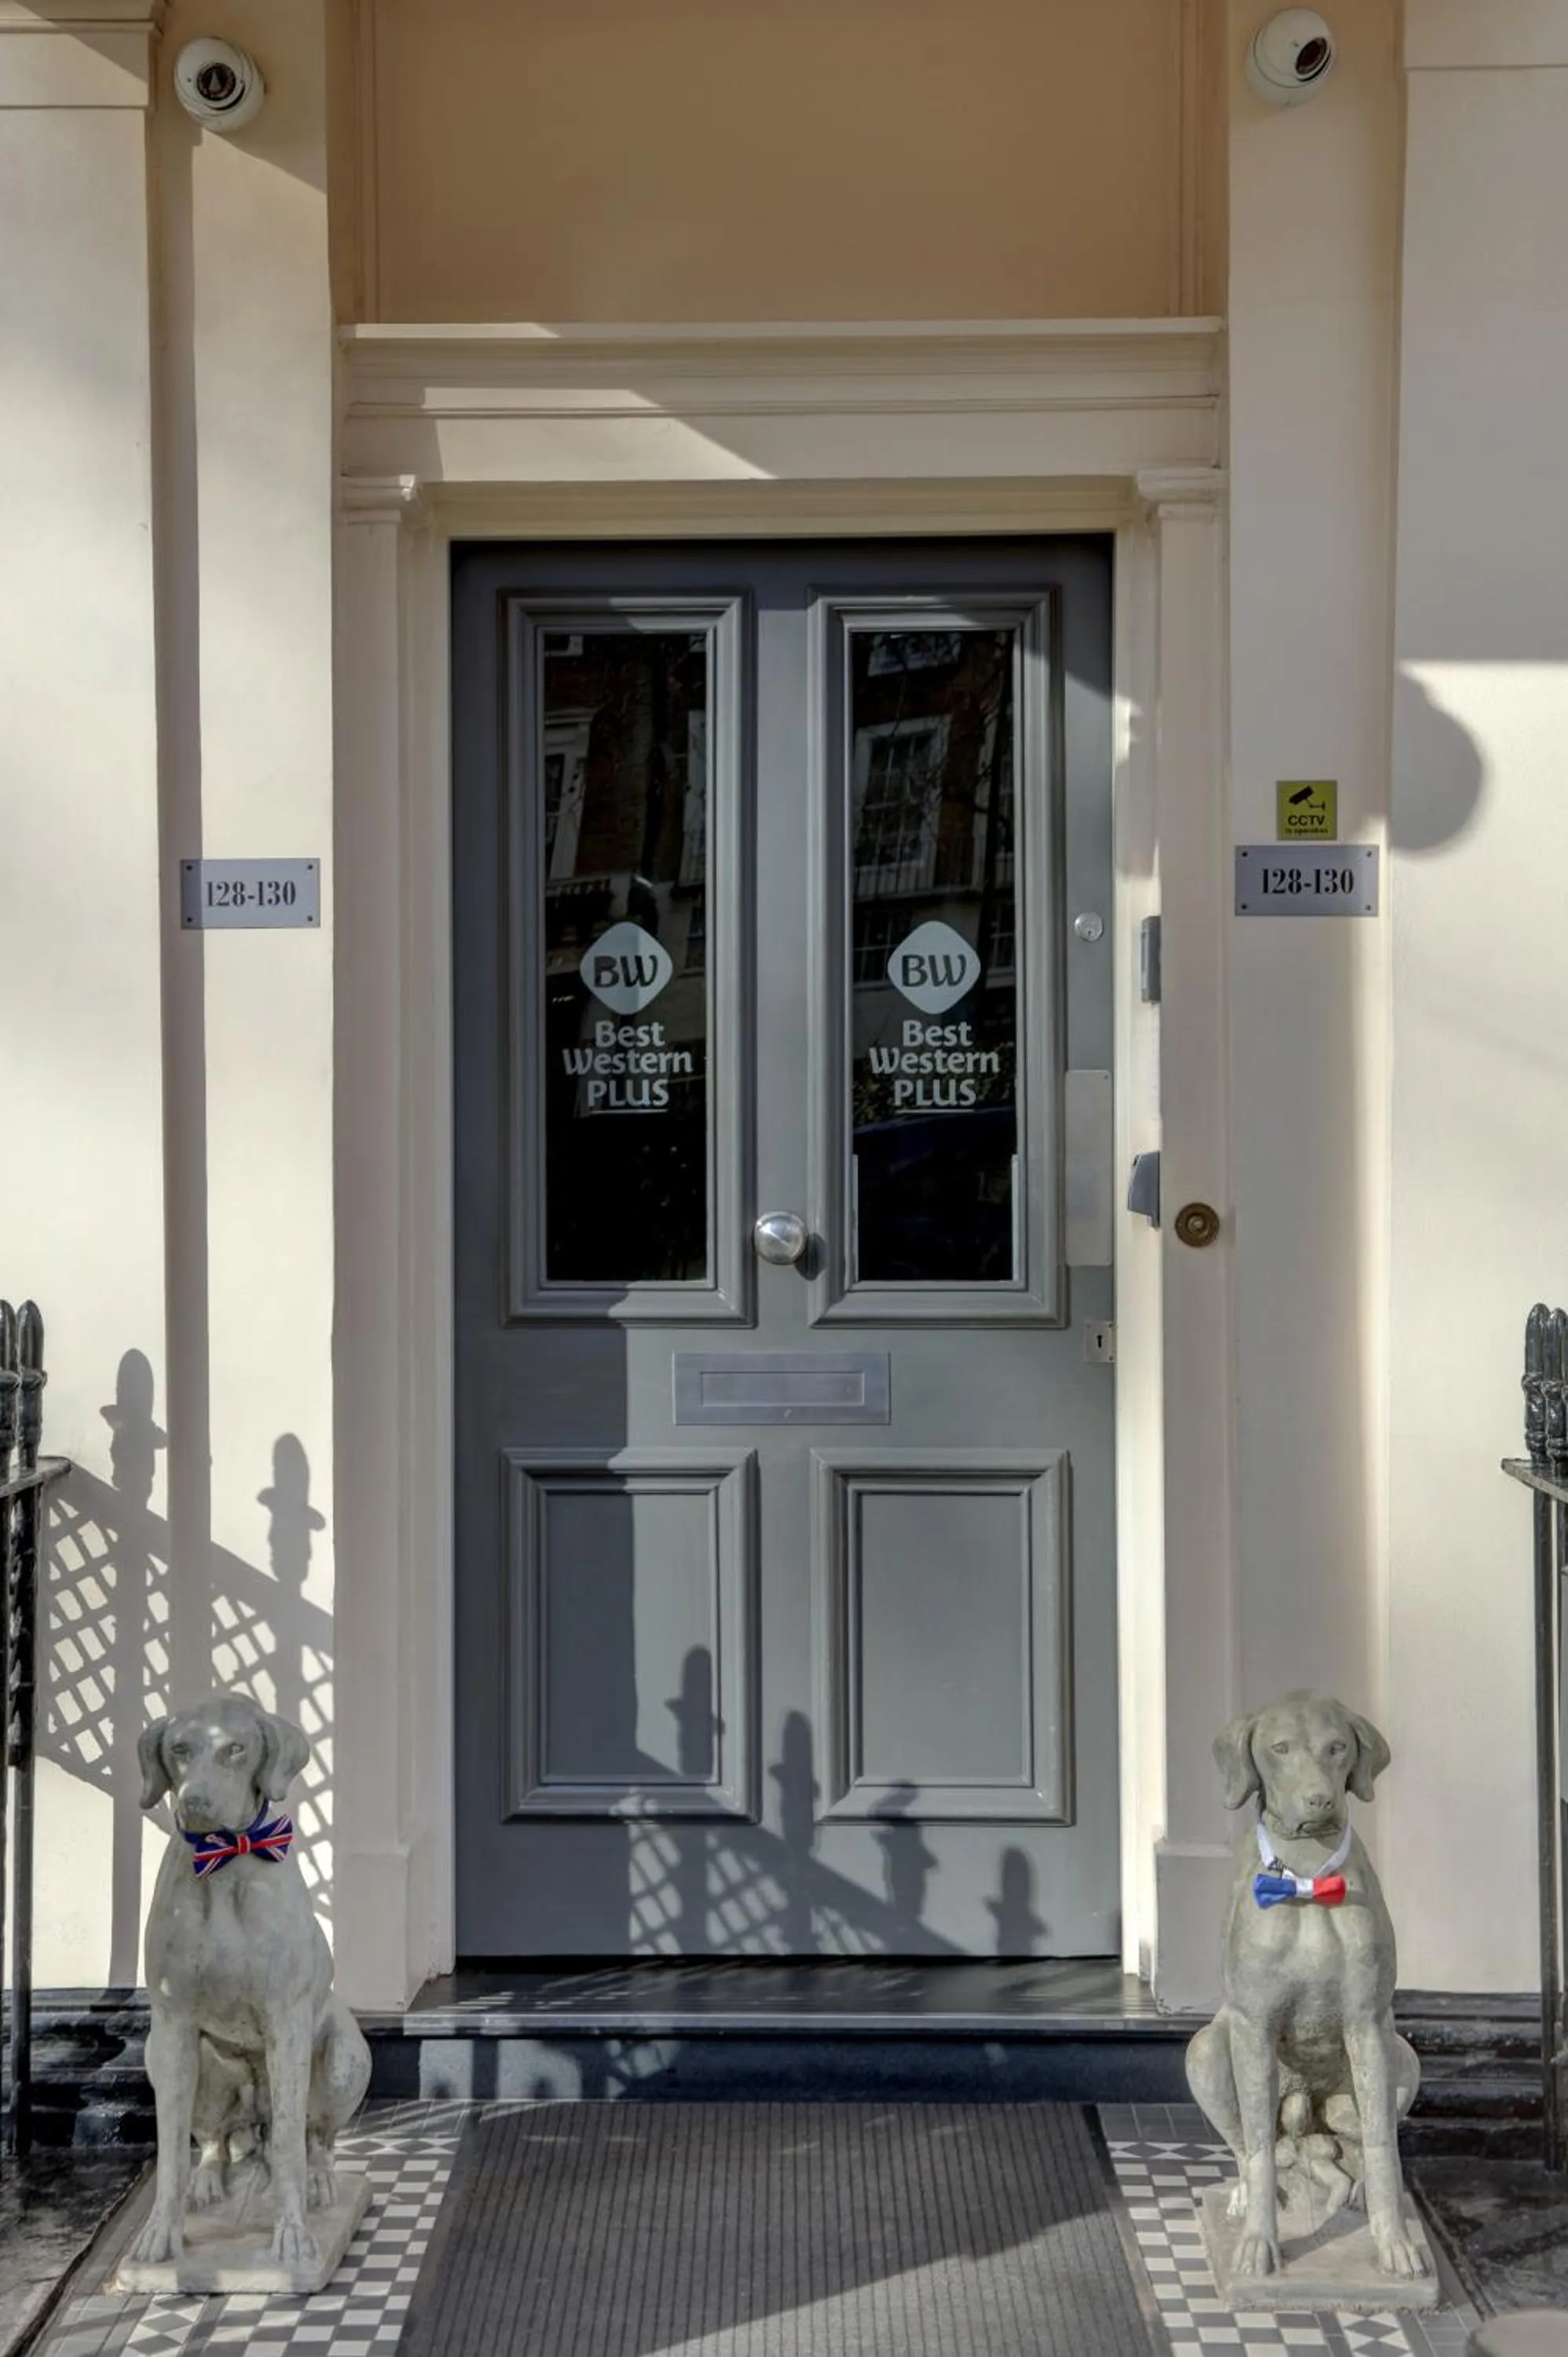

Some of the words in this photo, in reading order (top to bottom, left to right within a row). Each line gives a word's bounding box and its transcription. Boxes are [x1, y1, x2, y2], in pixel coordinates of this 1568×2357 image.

[1288, 815, 1325, 826] CCTV
[207, 880, 296, 907] 128-130
[1262, 868, 1354, 894] 128-130
[595, 955, 658, 988] BW
[902, 955, 967, 988] BW
[595, 1021, 665, 1047] Best
[903, 1020, 973, 1047] Best
[562, 1048, 694, 1075] Western
[870, 1047, 1000, 1075] Western
[588, 1079, 669, 1107] PLUS
[893, 1079, 977, 1106] PLUS
